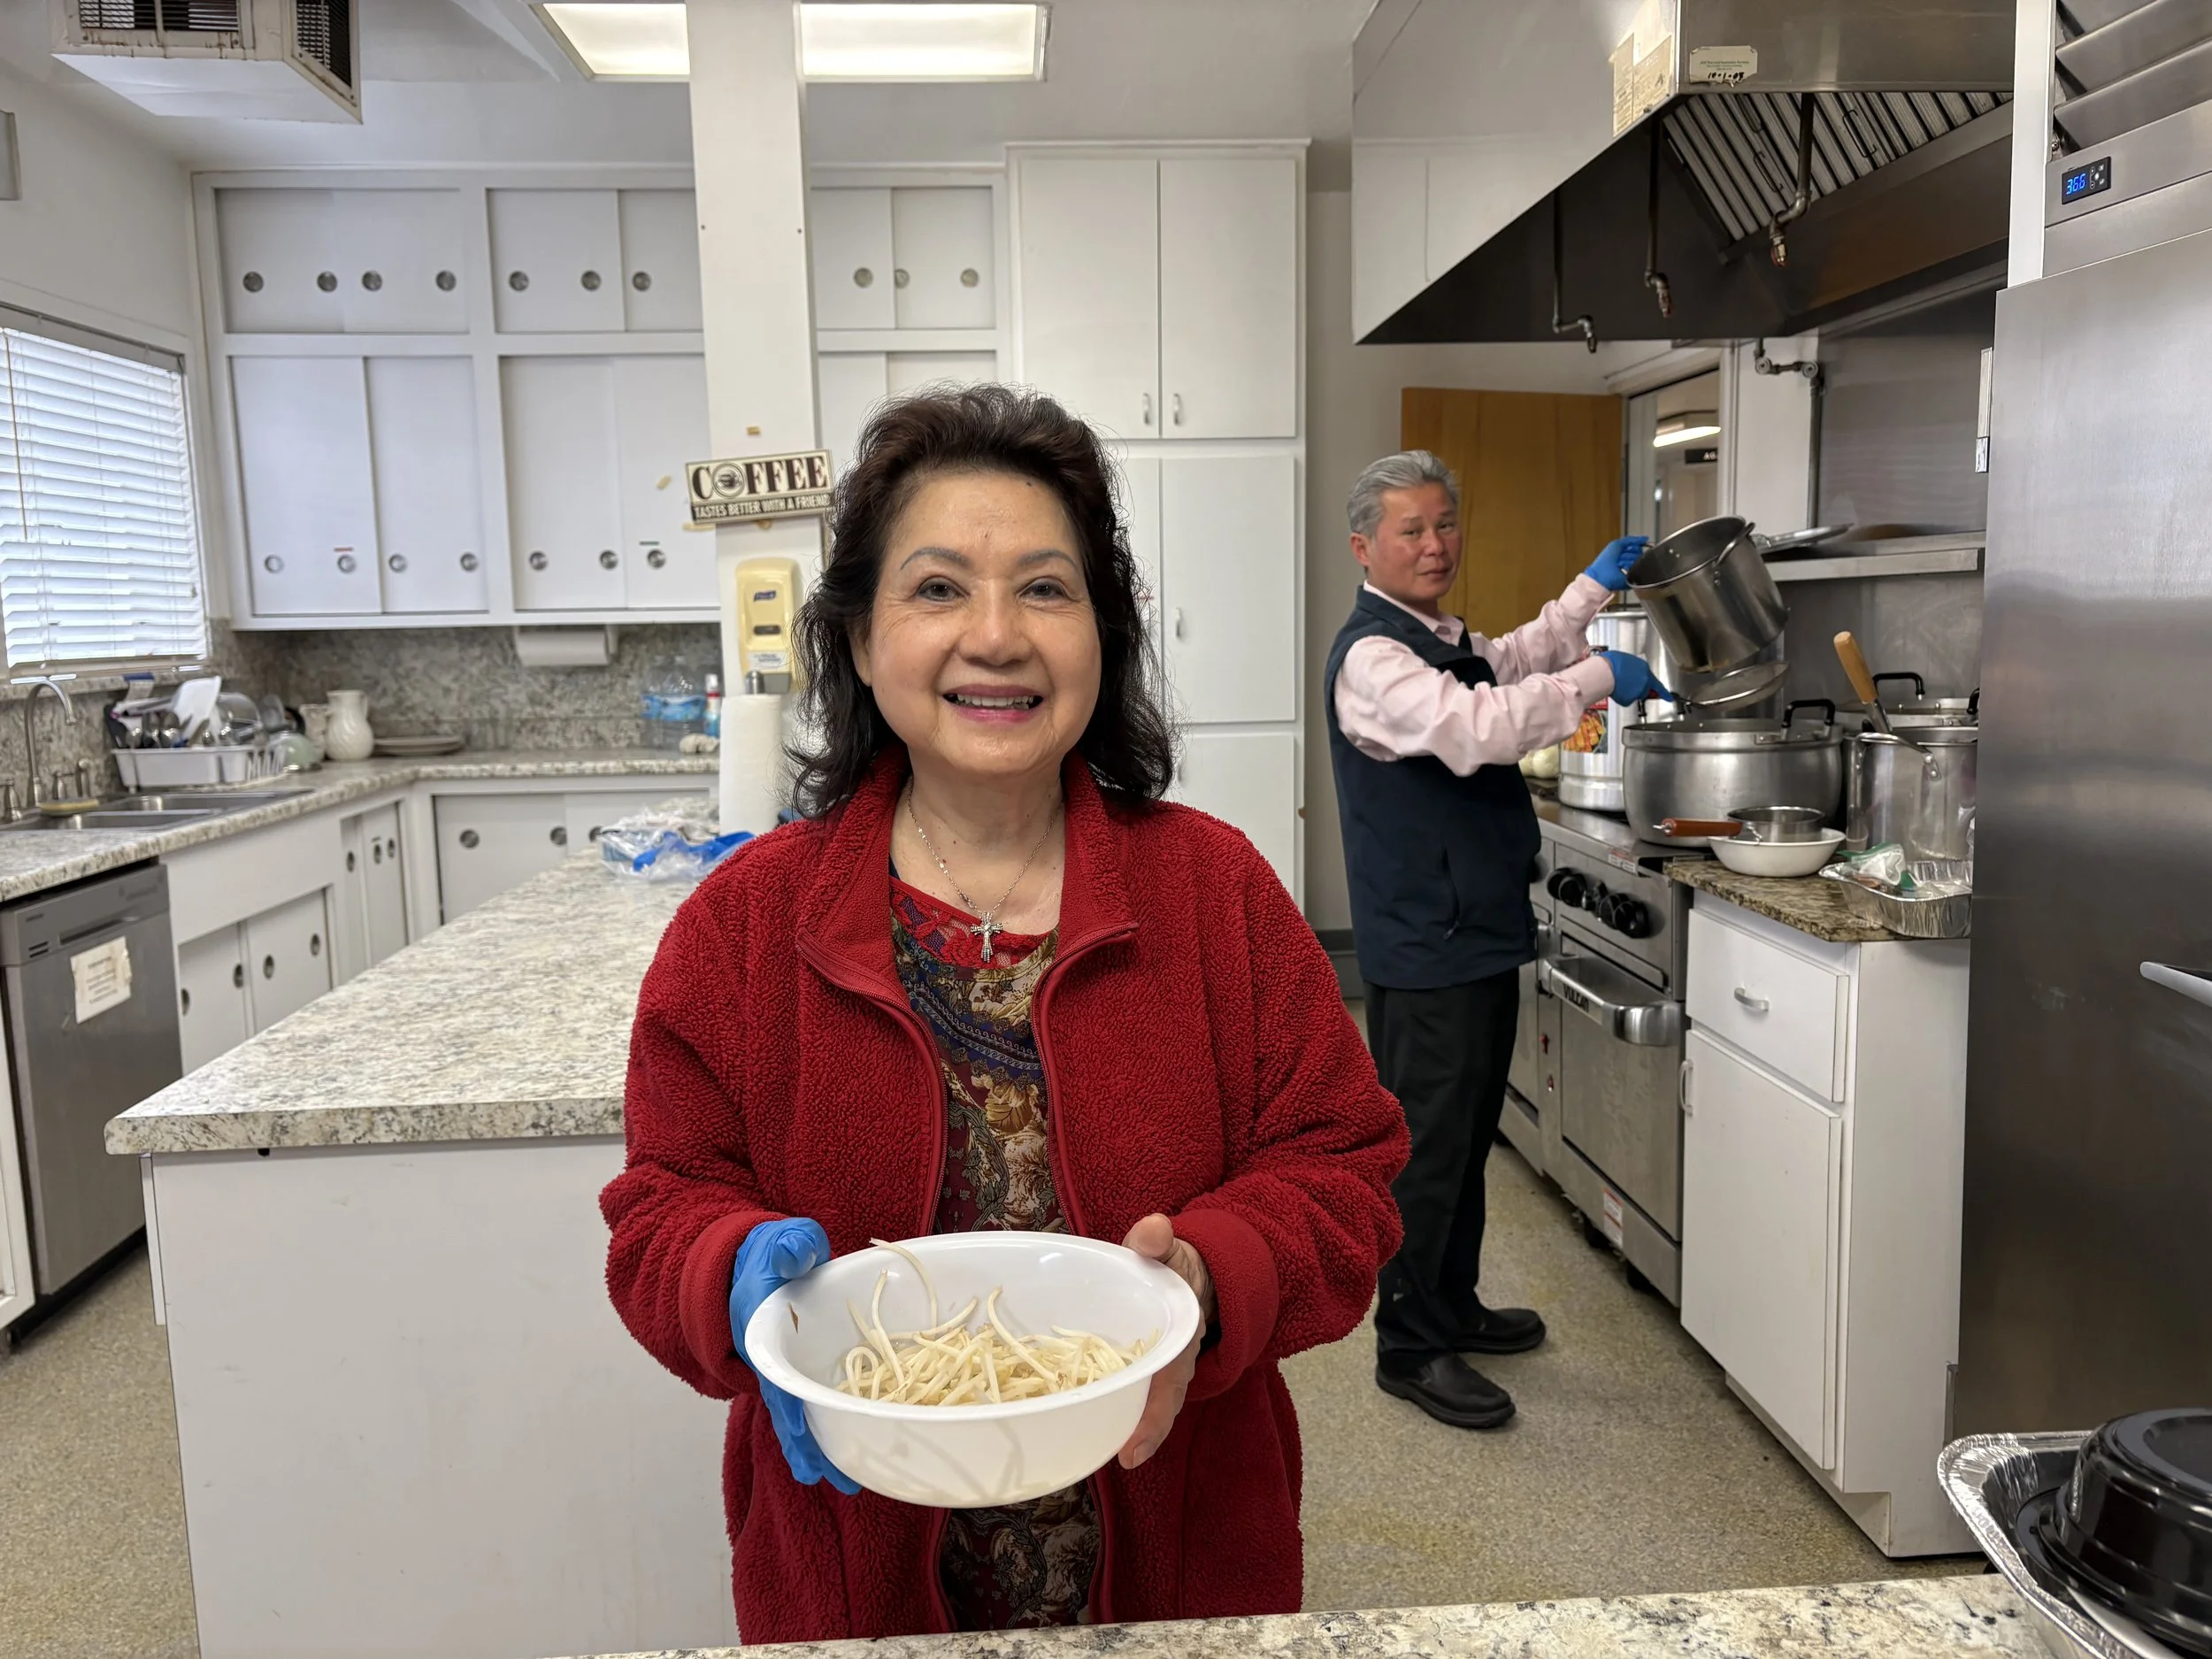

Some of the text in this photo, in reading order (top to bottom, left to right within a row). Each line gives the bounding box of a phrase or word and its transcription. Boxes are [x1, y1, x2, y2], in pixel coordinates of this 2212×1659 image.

[692, 456, 828, 500] COFFEE
[694, 503, 727, 518] TASTES
[728, 500, 762, 516] BETTER
[762, 497, 786, 513] WITH
[787, 498, 795, 510] A
